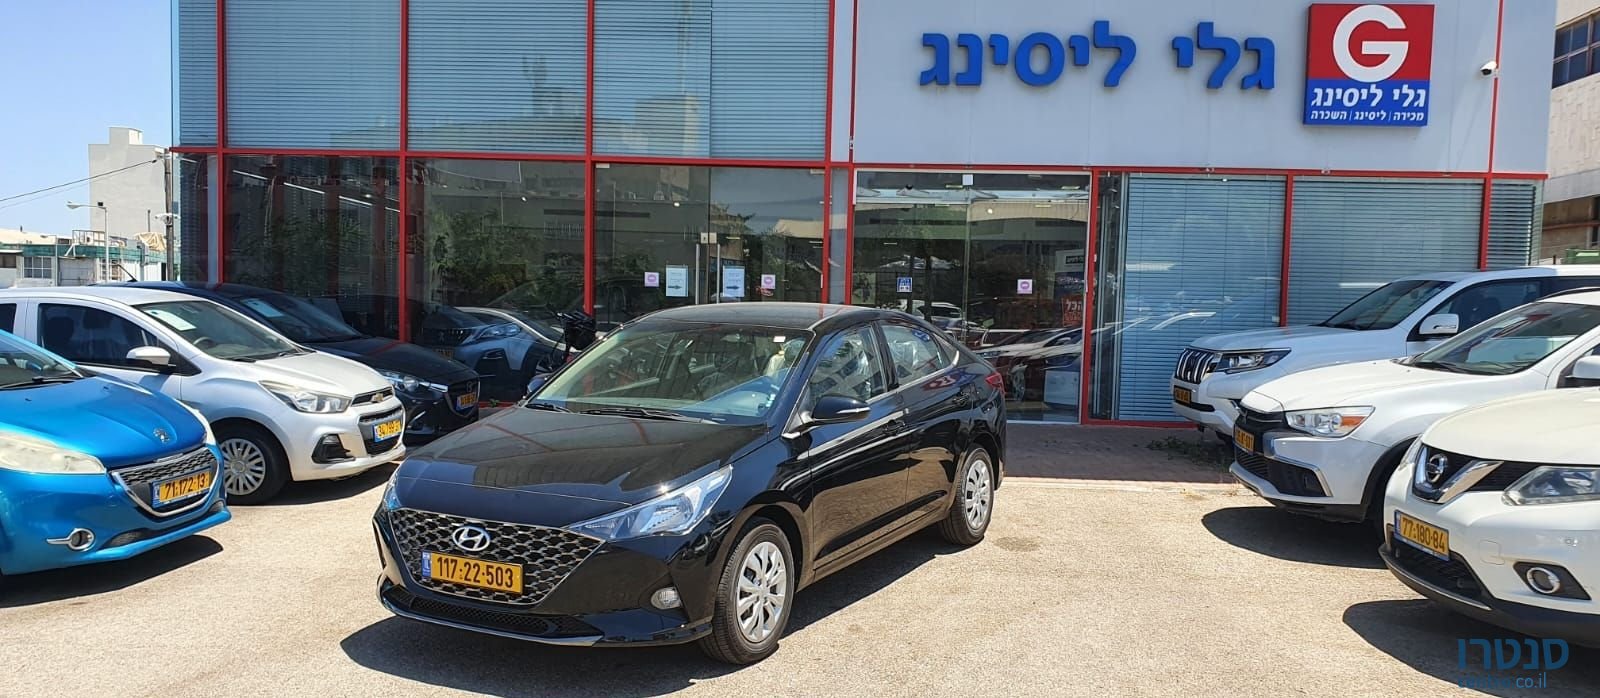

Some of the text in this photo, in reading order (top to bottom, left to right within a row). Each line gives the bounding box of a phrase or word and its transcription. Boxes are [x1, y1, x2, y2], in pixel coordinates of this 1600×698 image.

[920, 20, 1275, 90] גלי ליסינג
[1333, 4, 1409, 83] G
[1310, 84, 1426, 107] גלי ליסינג
[1310, 110, 1424, 121] מכירה ליסינג השכרה
